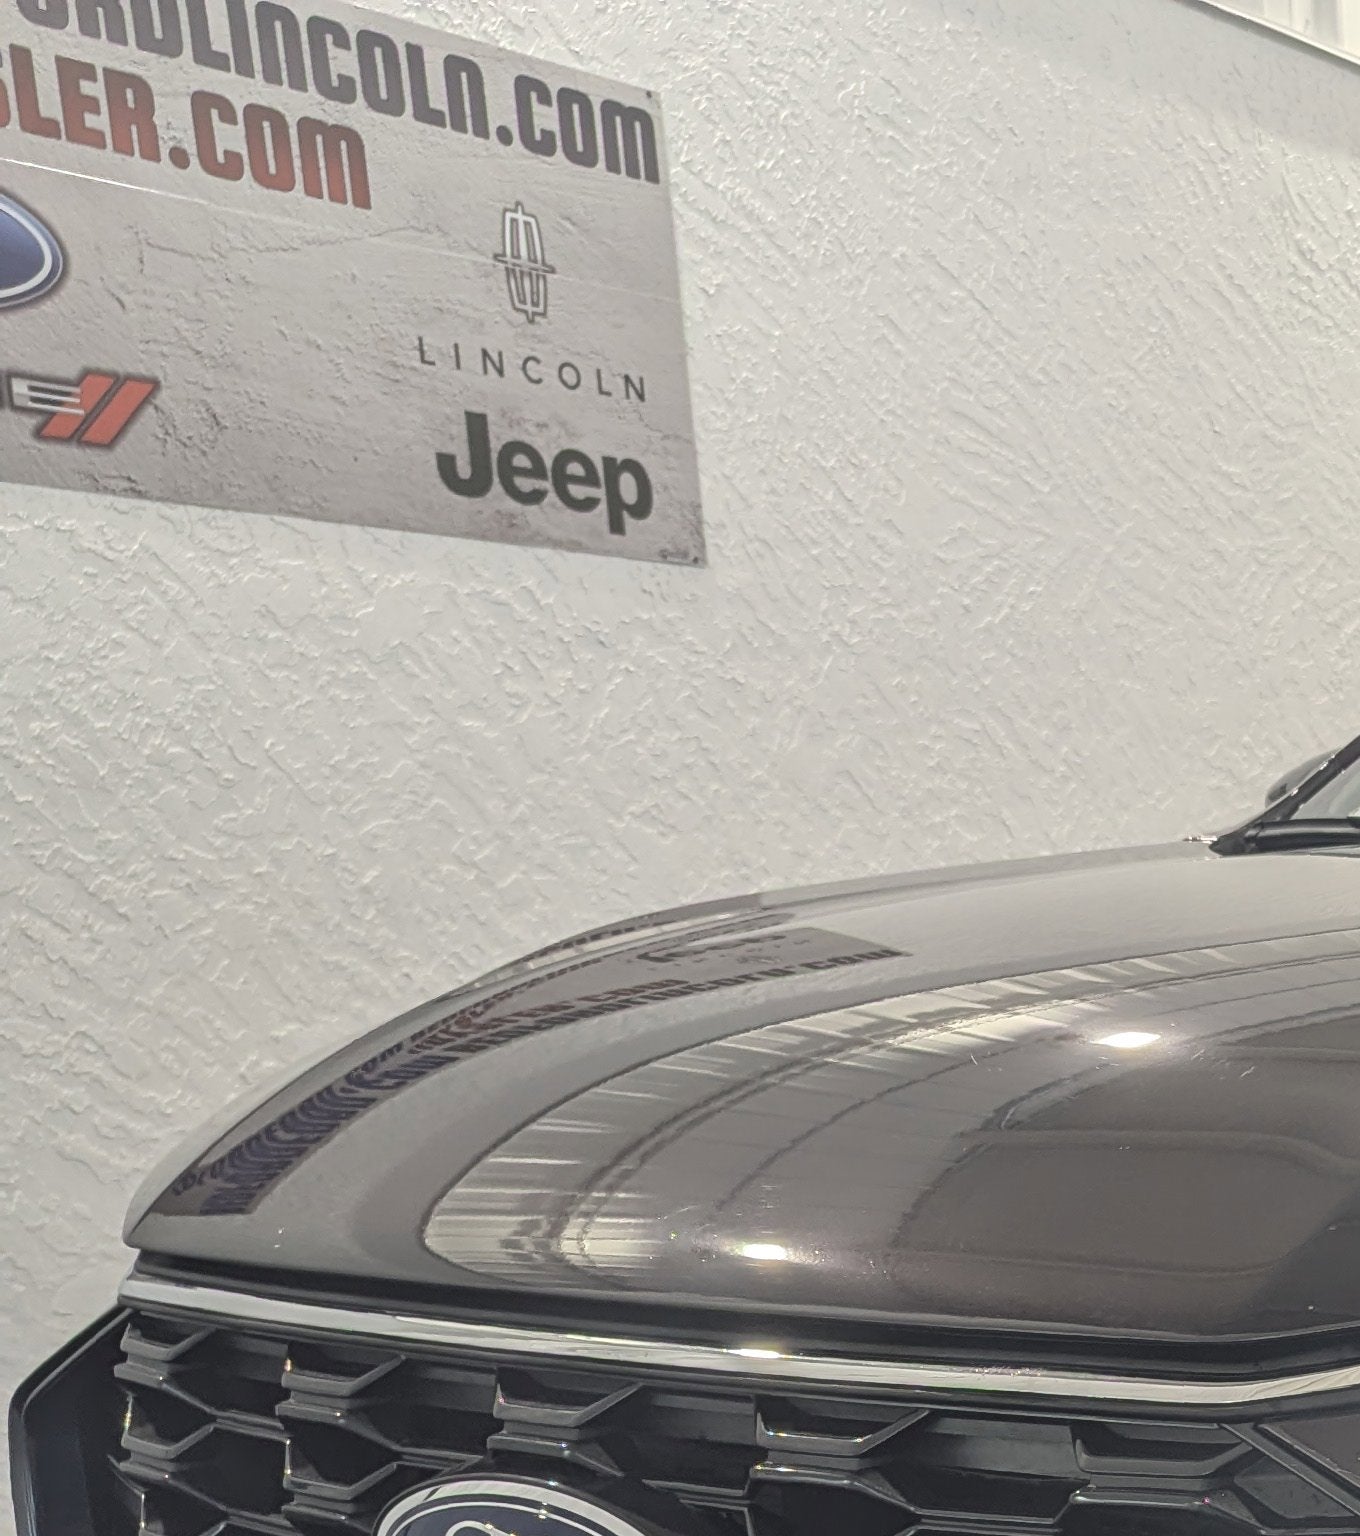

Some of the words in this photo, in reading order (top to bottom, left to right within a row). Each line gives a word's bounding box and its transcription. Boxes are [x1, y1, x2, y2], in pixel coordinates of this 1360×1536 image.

[0, 43, 372, 210] LER.COM
[417, 336, 647, 402] LINCOLN
[435, 410, 654, 537] Jeep
